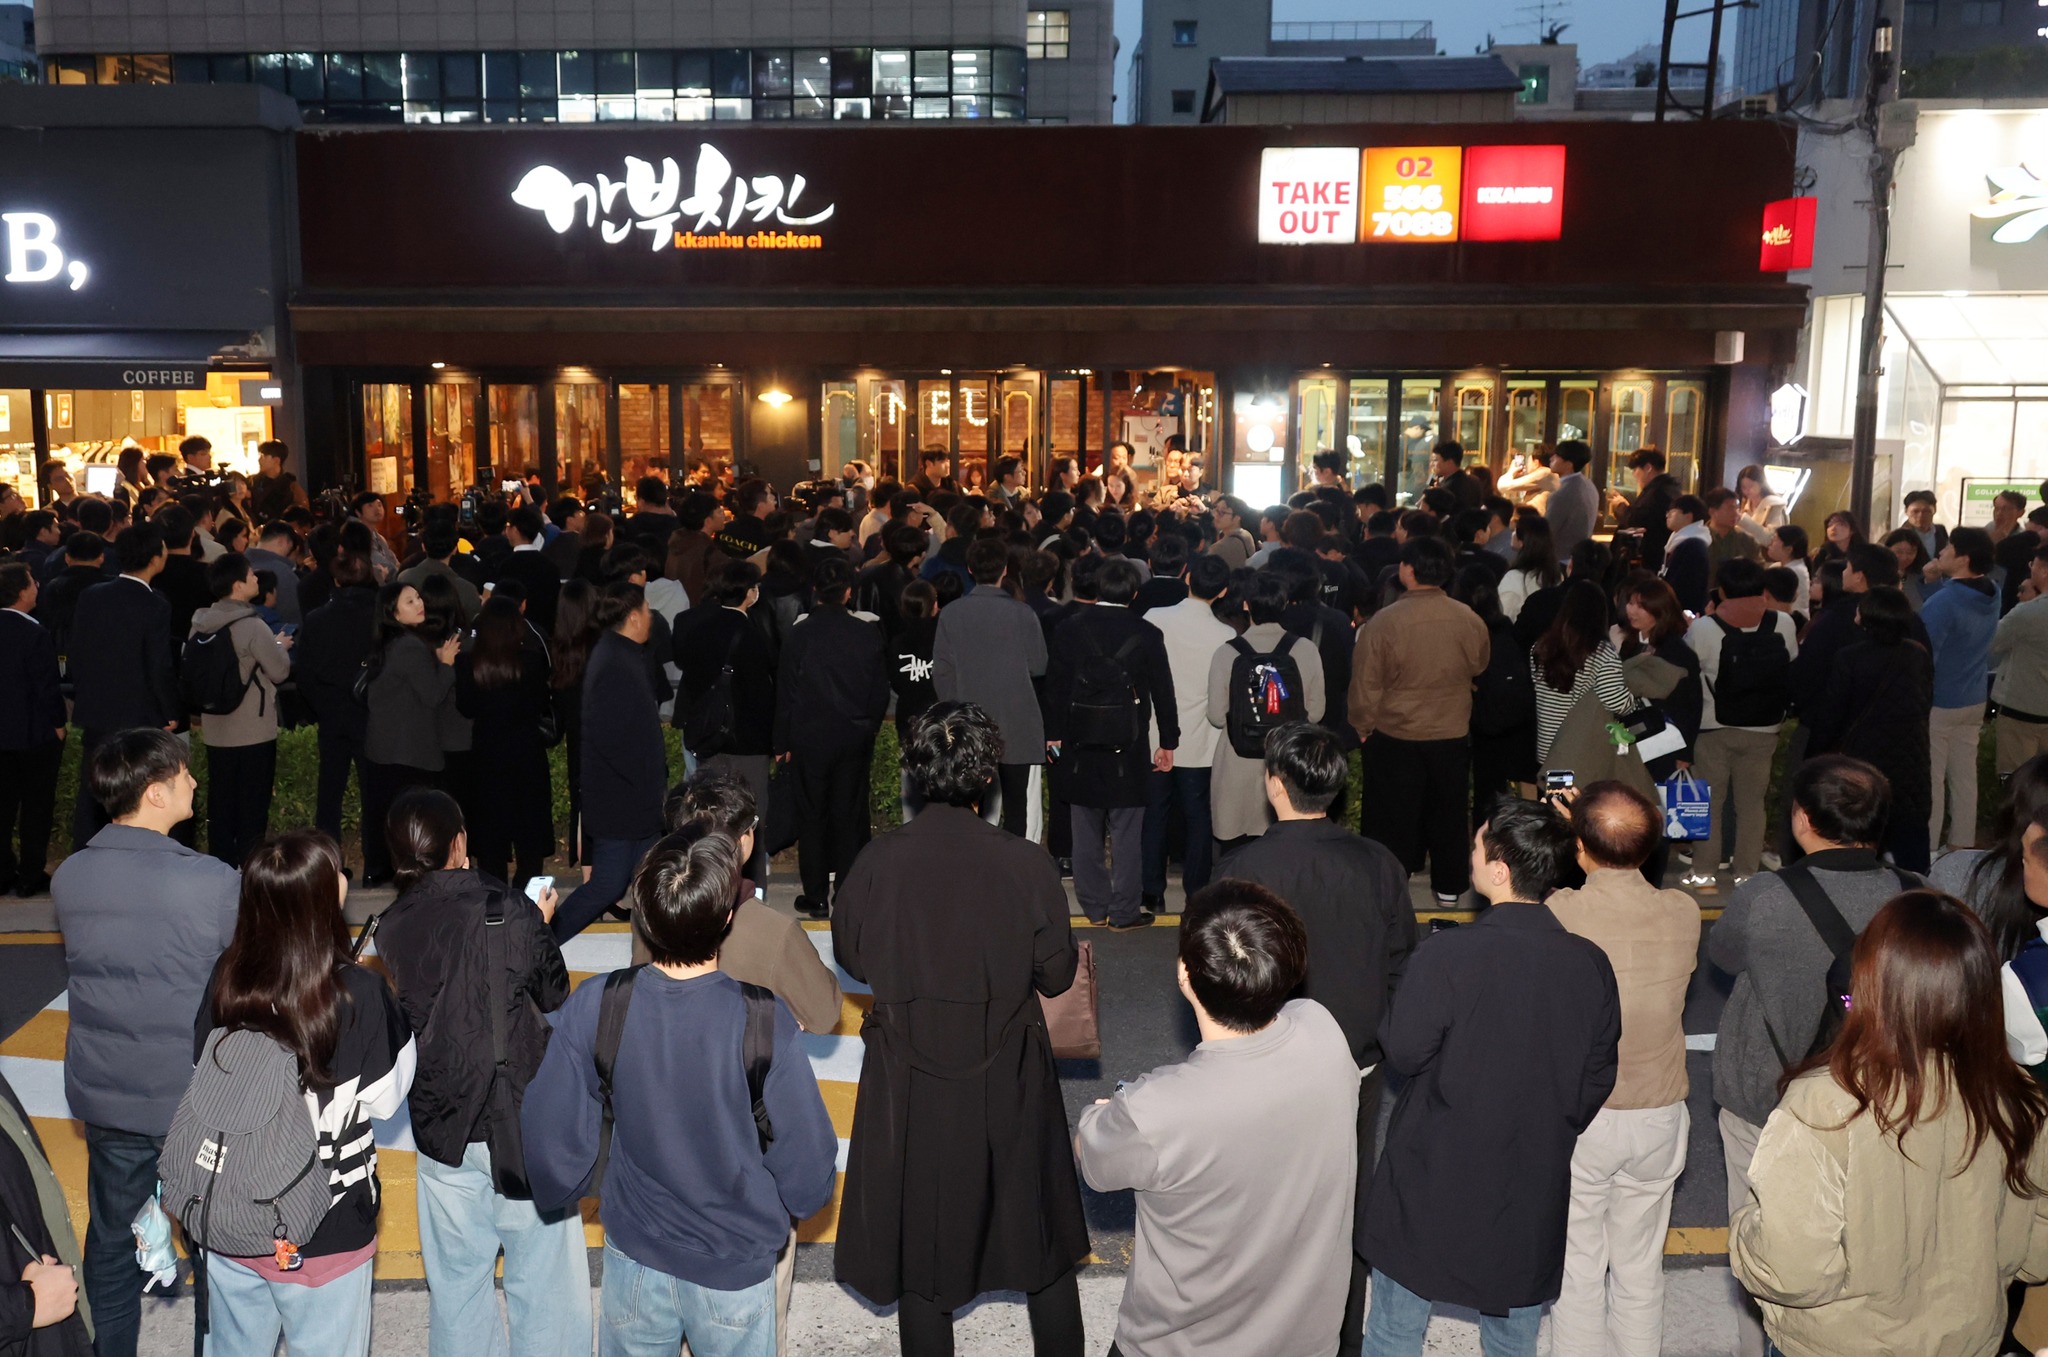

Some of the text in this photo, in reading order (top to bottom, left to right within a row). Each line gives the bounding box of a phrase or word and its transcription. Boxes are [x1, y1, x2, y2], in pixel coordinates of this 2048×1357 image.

[1395, 156, 1434, 178] 02
[511, 142, 834, 252] 깐부치킨
[1272, 181, 1351, 205] TAKE
[1383, 184, 1443, 211] 566
[1278, 210, 1341, 234] OUT
[1371, 211, 1453, 237] 7088
[674, 231, 822, 249] kkanbu chicken
[123, 370, 195, 385] COFFEE
